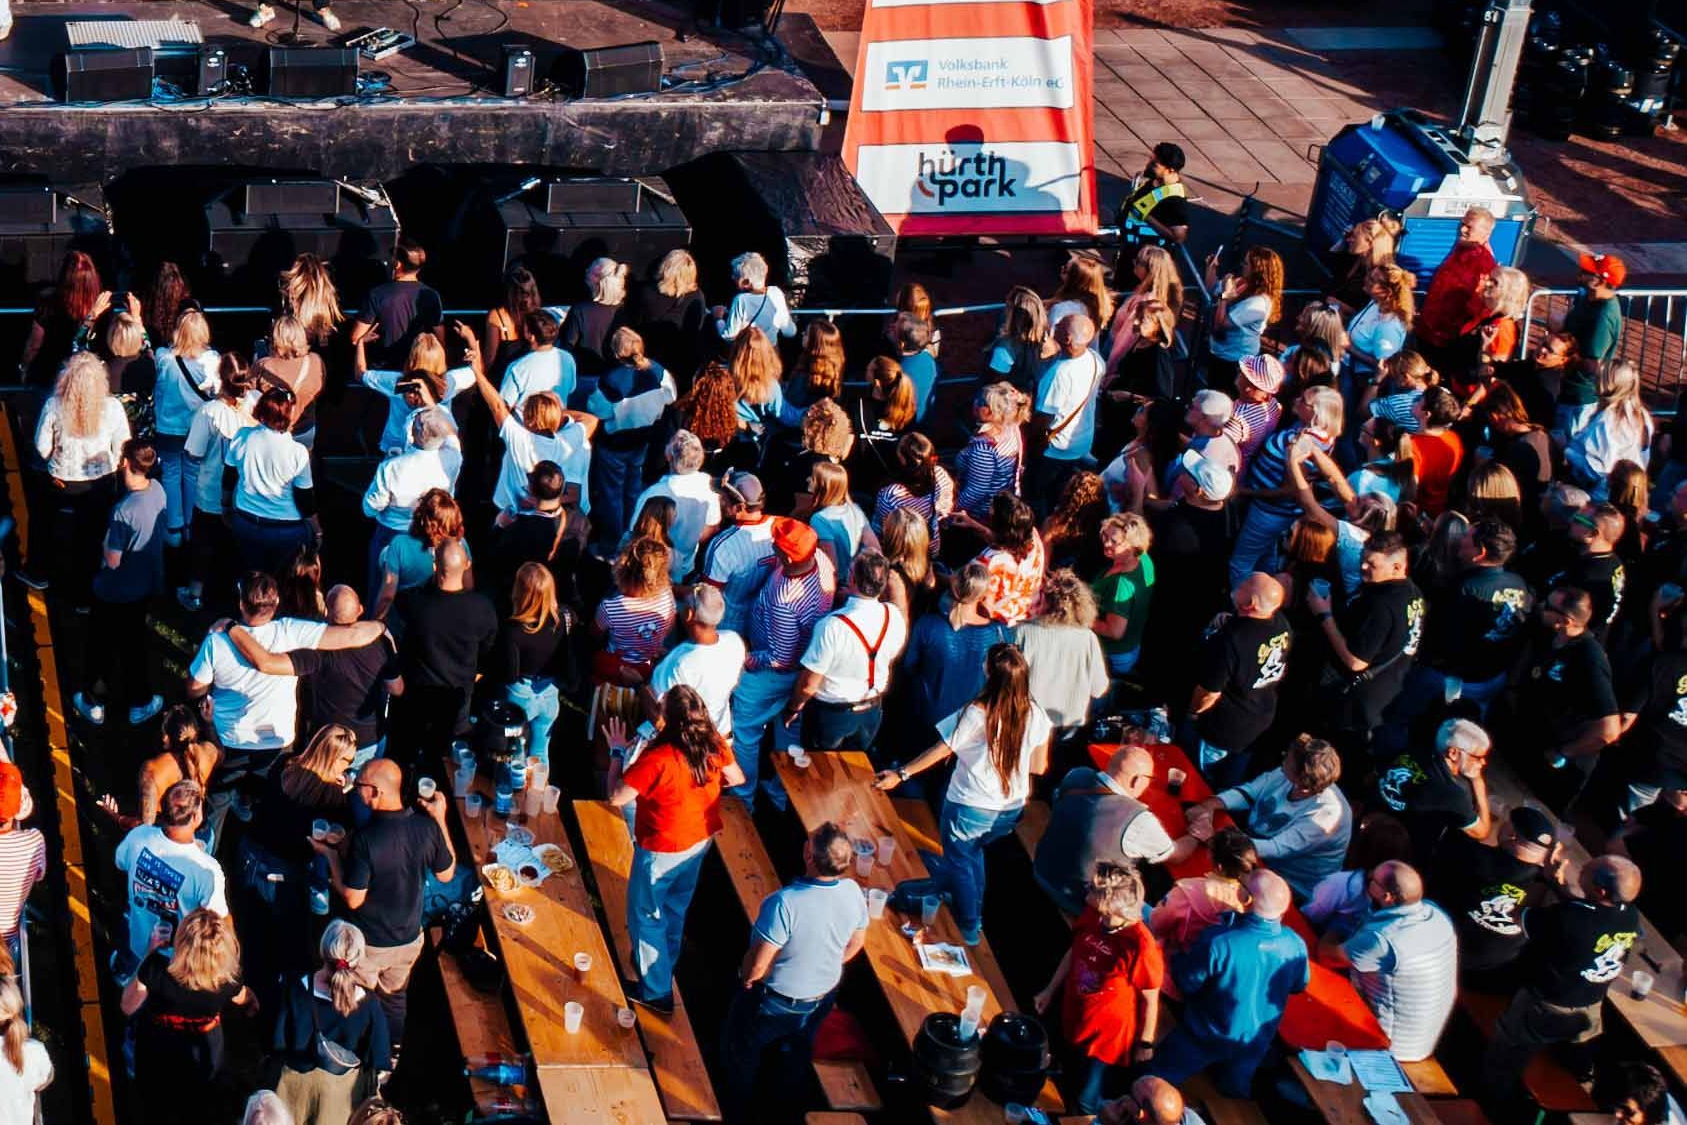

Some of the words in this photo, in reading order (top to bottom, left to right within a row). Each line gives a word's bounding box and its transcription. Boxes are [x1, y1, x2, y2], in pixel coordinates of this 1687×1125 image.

[937, 58, 1009, 71] Volksbank
[936, 75, 1043, 89] Rhein-Erft-Köln
[917, 149, 1007, 178] hürth
[934, 176, 1017, 207] park
